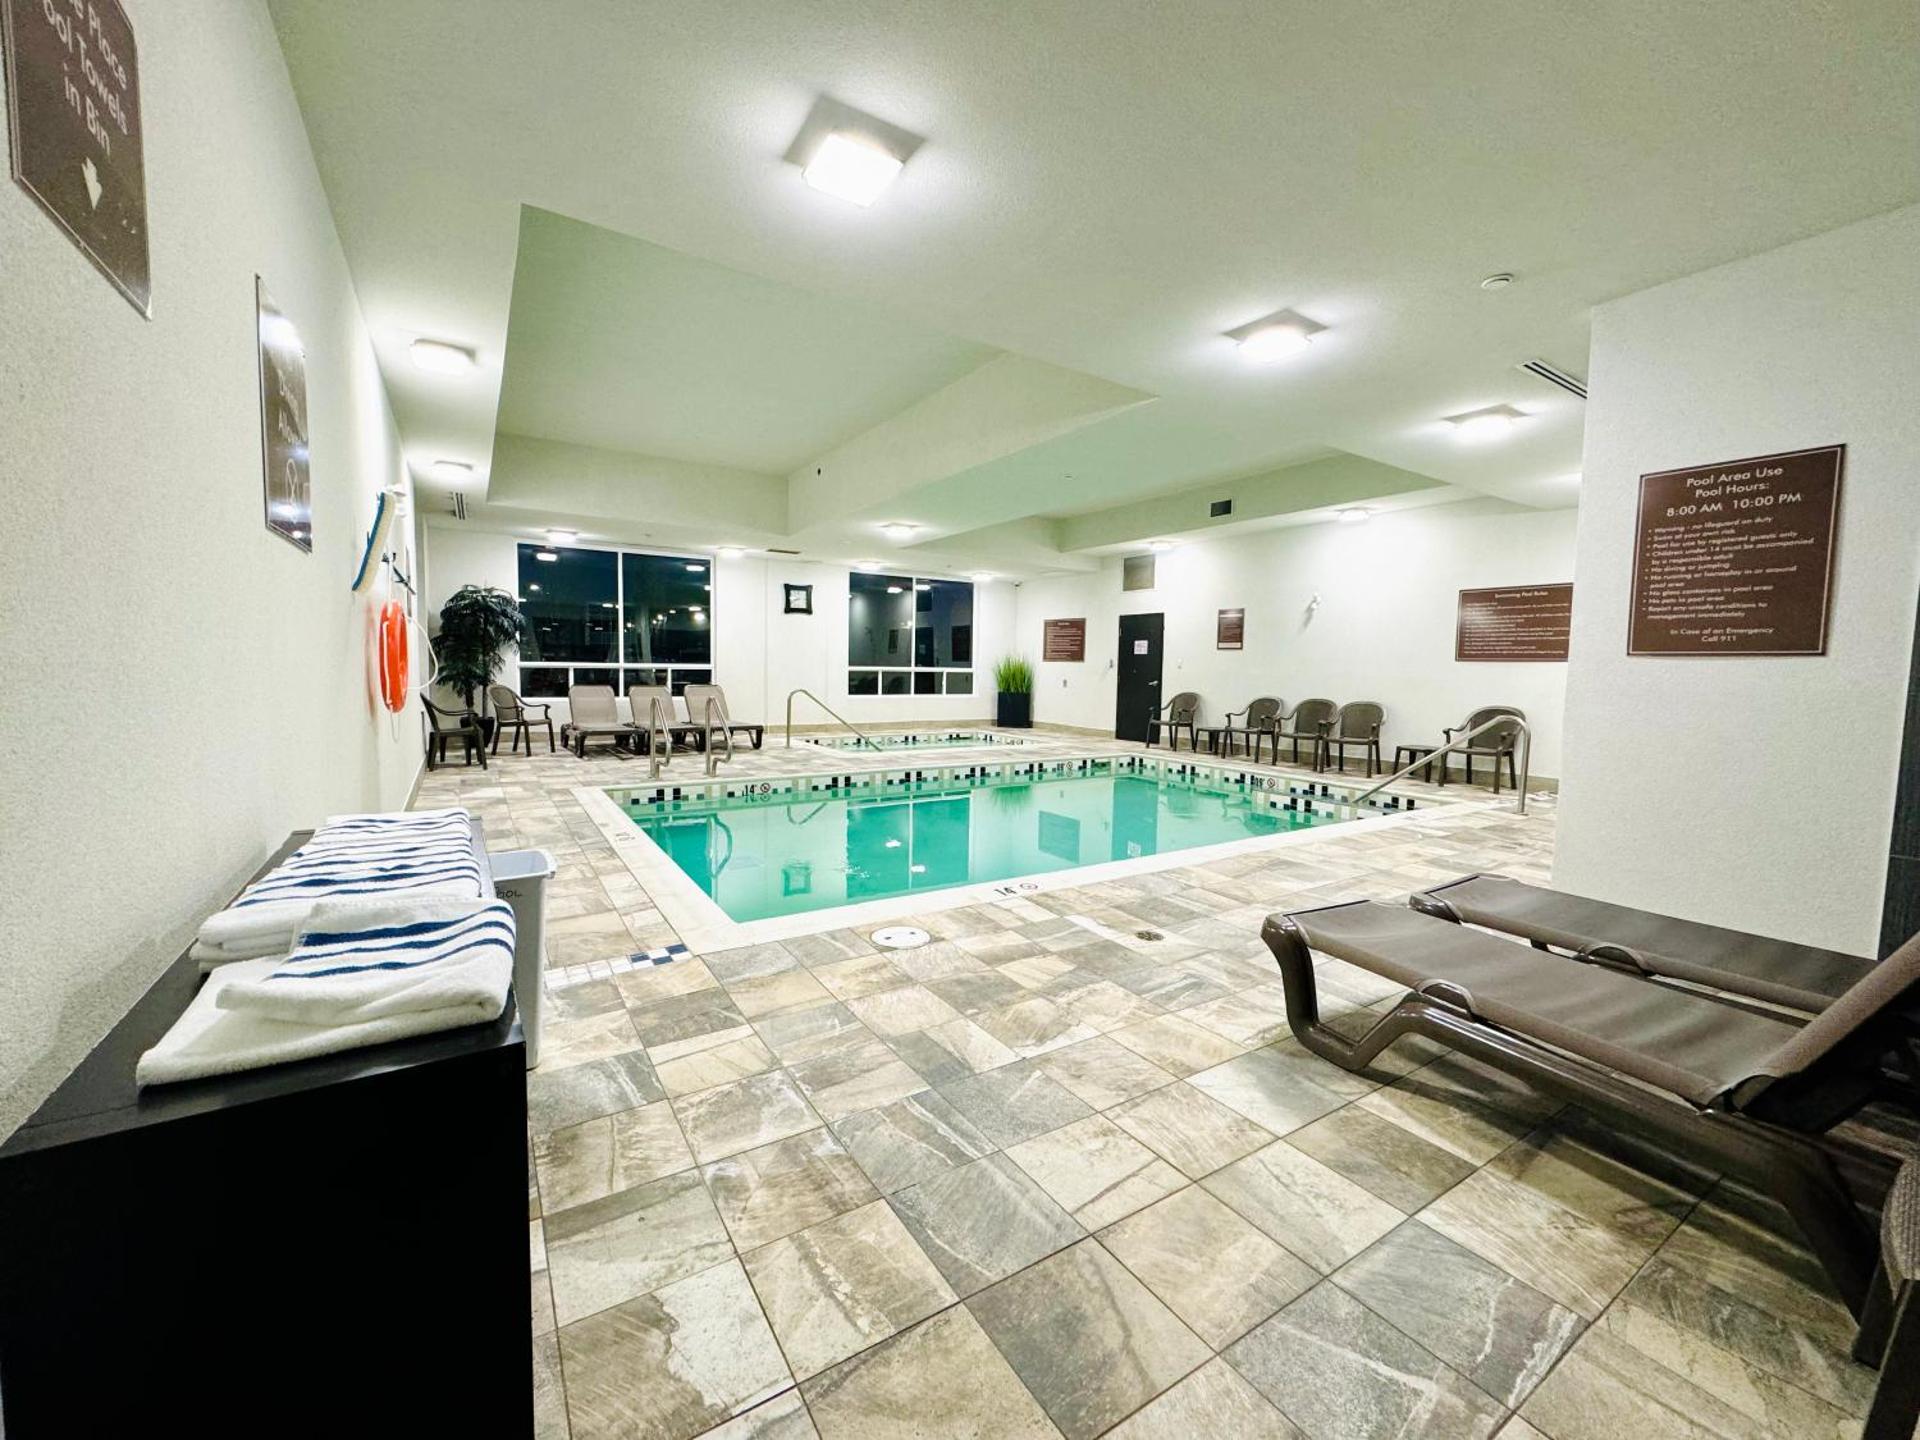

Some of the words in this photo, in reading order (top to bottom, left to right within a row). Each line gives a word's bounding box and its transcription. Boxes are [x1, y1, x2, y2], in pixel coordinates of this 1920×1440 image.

[43, 0, 73, 53] ool
[75, 31, 128, 136] Towels
[87, 3, 127, 91] Place
[63, 62, 81, 116] in
[86, 95, 110, 156] Bin
[1666, 505, 1697, 517] 8:00
[1699, 503, 1723, 513] AM
[1732, 495, 1774, 509] 10:00
[1778, 492, 1802, 504] PM
[1686, 475, 1714, 488] Pool
[1717, 471, 1751, 483] Area
[1755, 467, 1784, 478] Use
[1695, 486, 1722, 498] Pool
[1726, 482, 1770, 494] Hours:
